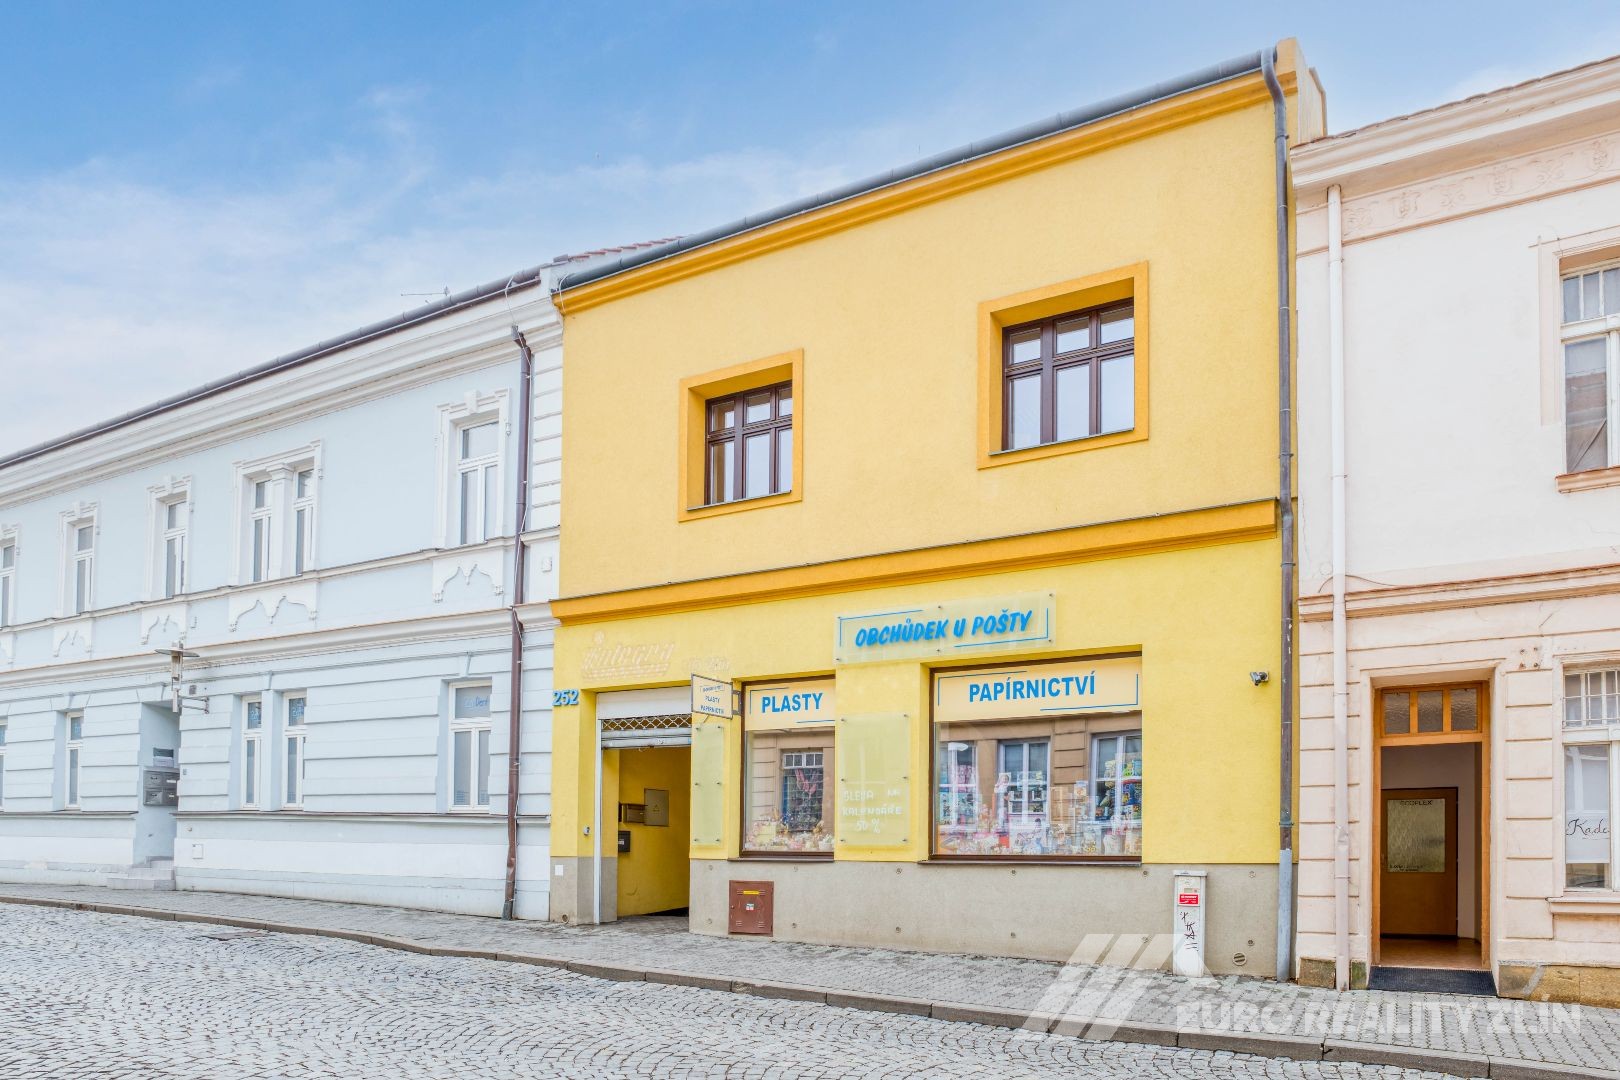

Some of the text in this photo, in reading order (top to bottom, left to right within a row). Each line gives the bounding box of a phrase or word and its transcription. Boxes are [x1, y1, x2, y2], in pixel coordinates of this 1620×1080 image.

[855, 609, 1033, 647] OBCHŮDEK U POŠTY
[551, 689, 579, 706] 252
[969, 671, 1096, 703] PAPÍRNICTVÍ
[761, 692, 823, 714] PLASTY
[1565, 817, 1610, 836] Kade
